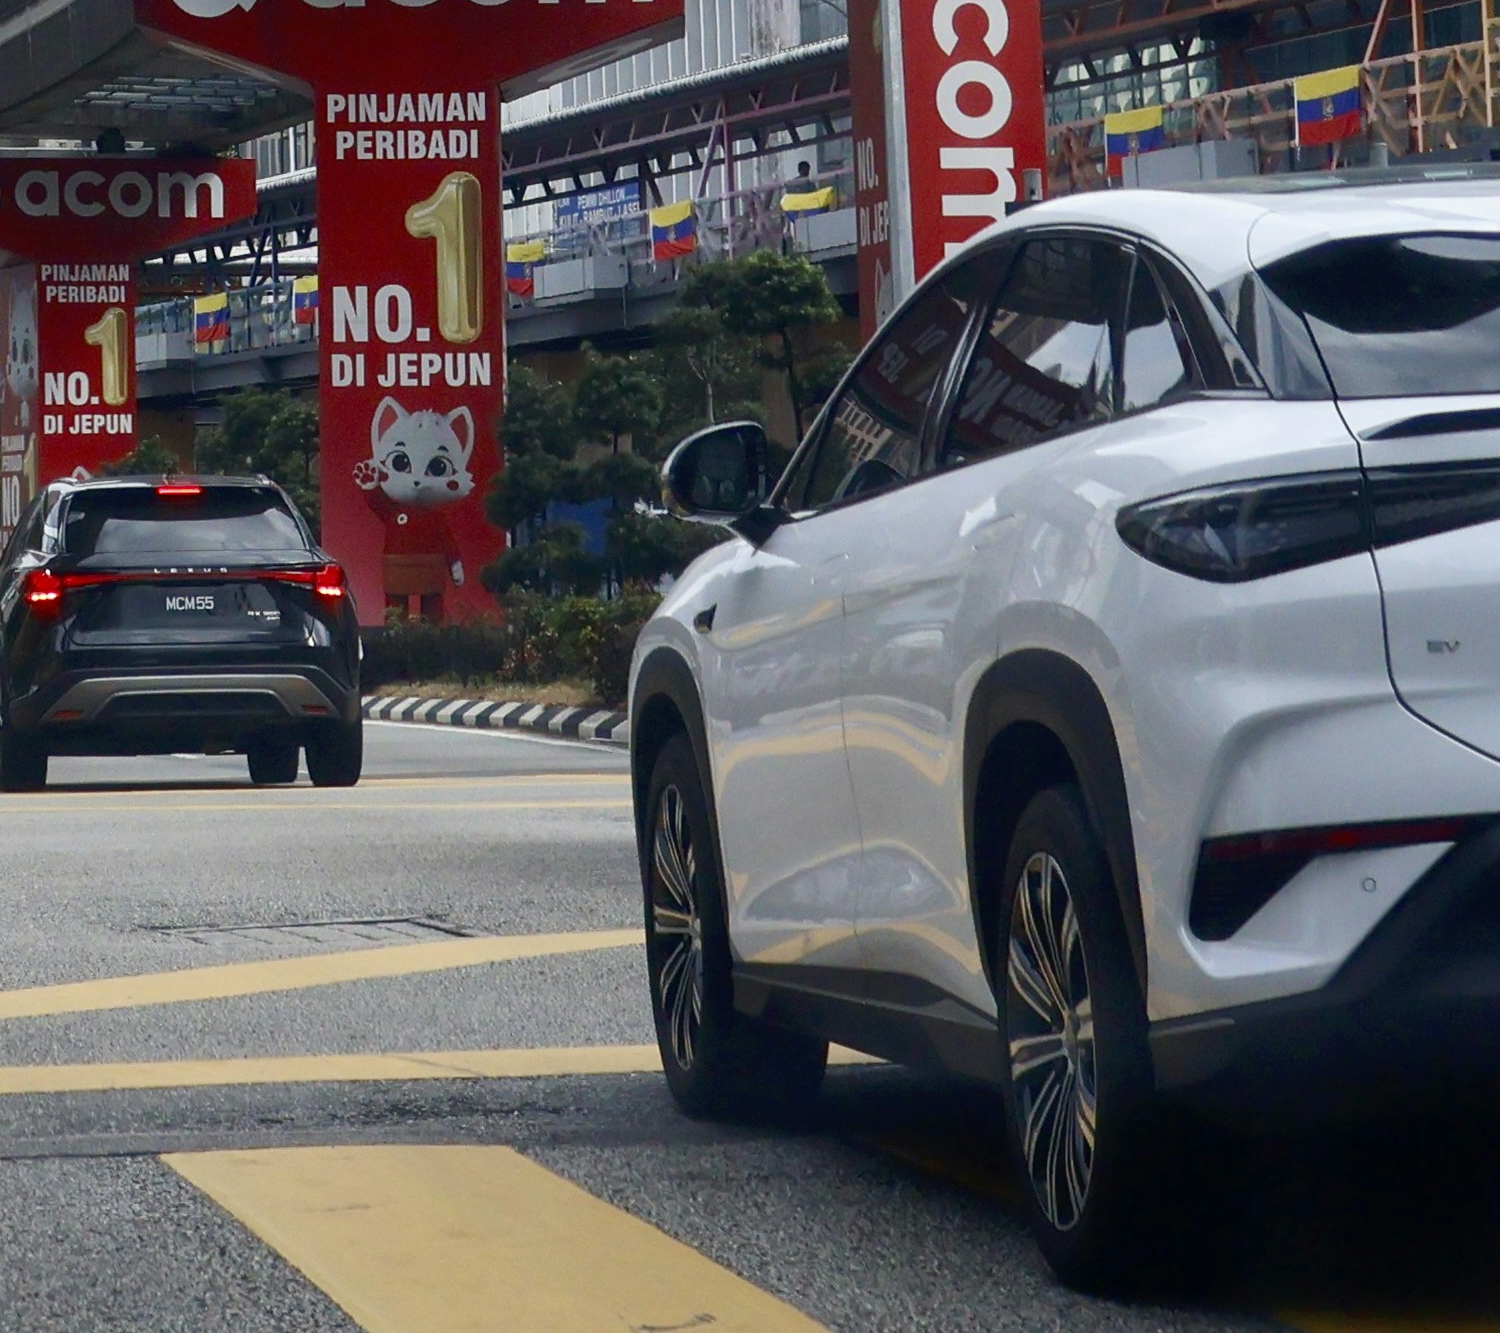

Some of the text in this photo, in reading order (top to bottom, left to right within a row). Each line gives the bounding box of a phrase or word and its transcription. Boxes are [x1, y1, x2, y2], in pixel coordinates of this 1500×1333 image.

[327, 92, 486, 123] PINJAMAN
[336, 129, 478, 160] PERIBADI
[15, 169, 224, 218] acom
[41, 264, 130, 282] PINJAMAN
[46, 286, 126, 303] PERIBADI
[332, 351, 491, 386] DI JEPUN
[43, 413, 132, 435] DI JEPUN
